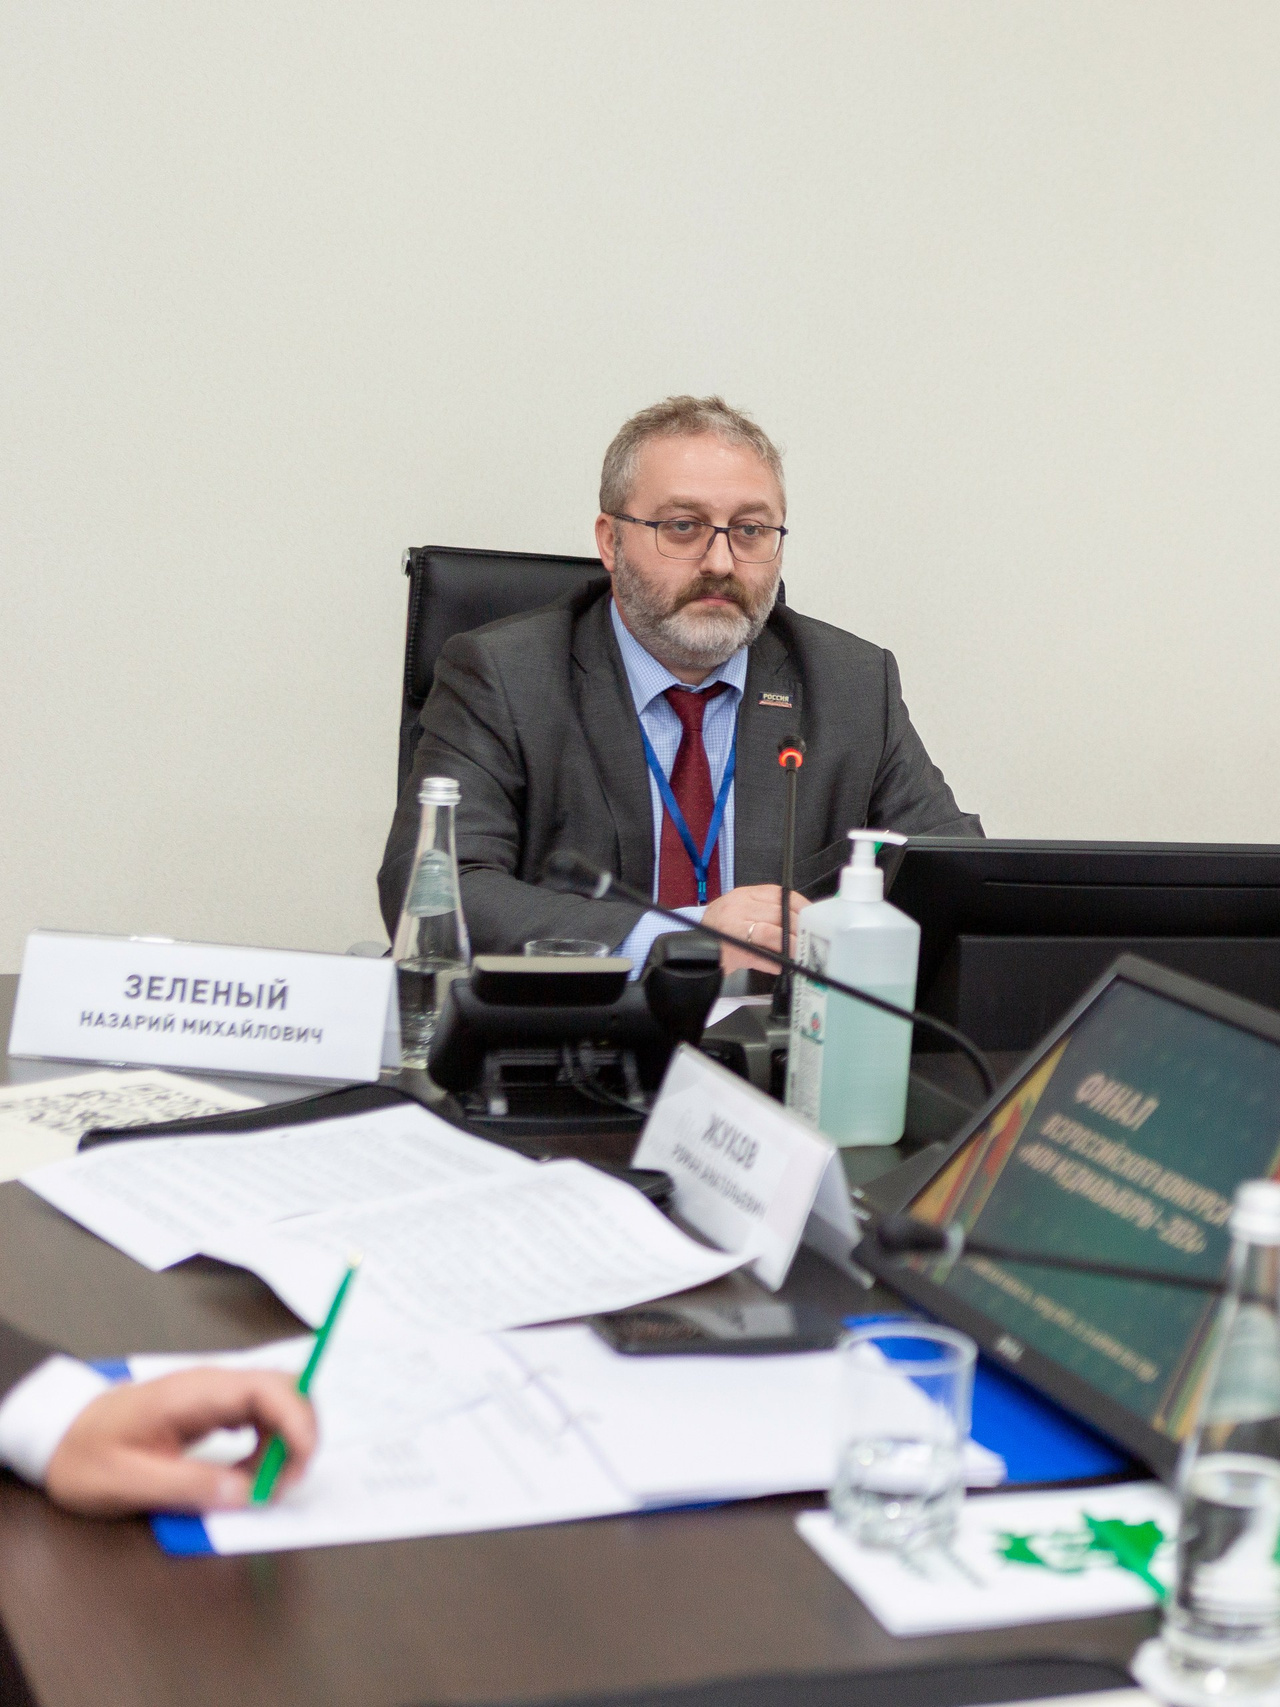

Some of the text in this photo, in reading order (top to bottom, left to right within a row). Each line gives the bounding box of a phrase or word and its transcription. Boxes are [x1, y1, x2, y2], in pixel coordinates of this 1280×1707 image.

[763, 693, 789, 702] РОССИЯ
[125, 973, 290, 1011] ЗЕЛЕНЫЙ
[80, 1010, 324, 1045] НАЗАРИЙ МИХАЙЛОВИЧ
[1075, 1072, 1160, 1132] ФИНАЛ
[701, 1113, 760, 1170] ЖУКОВ
[1040, 1112, 1163, 1188] ВСЕРОССИЙСКОГО
